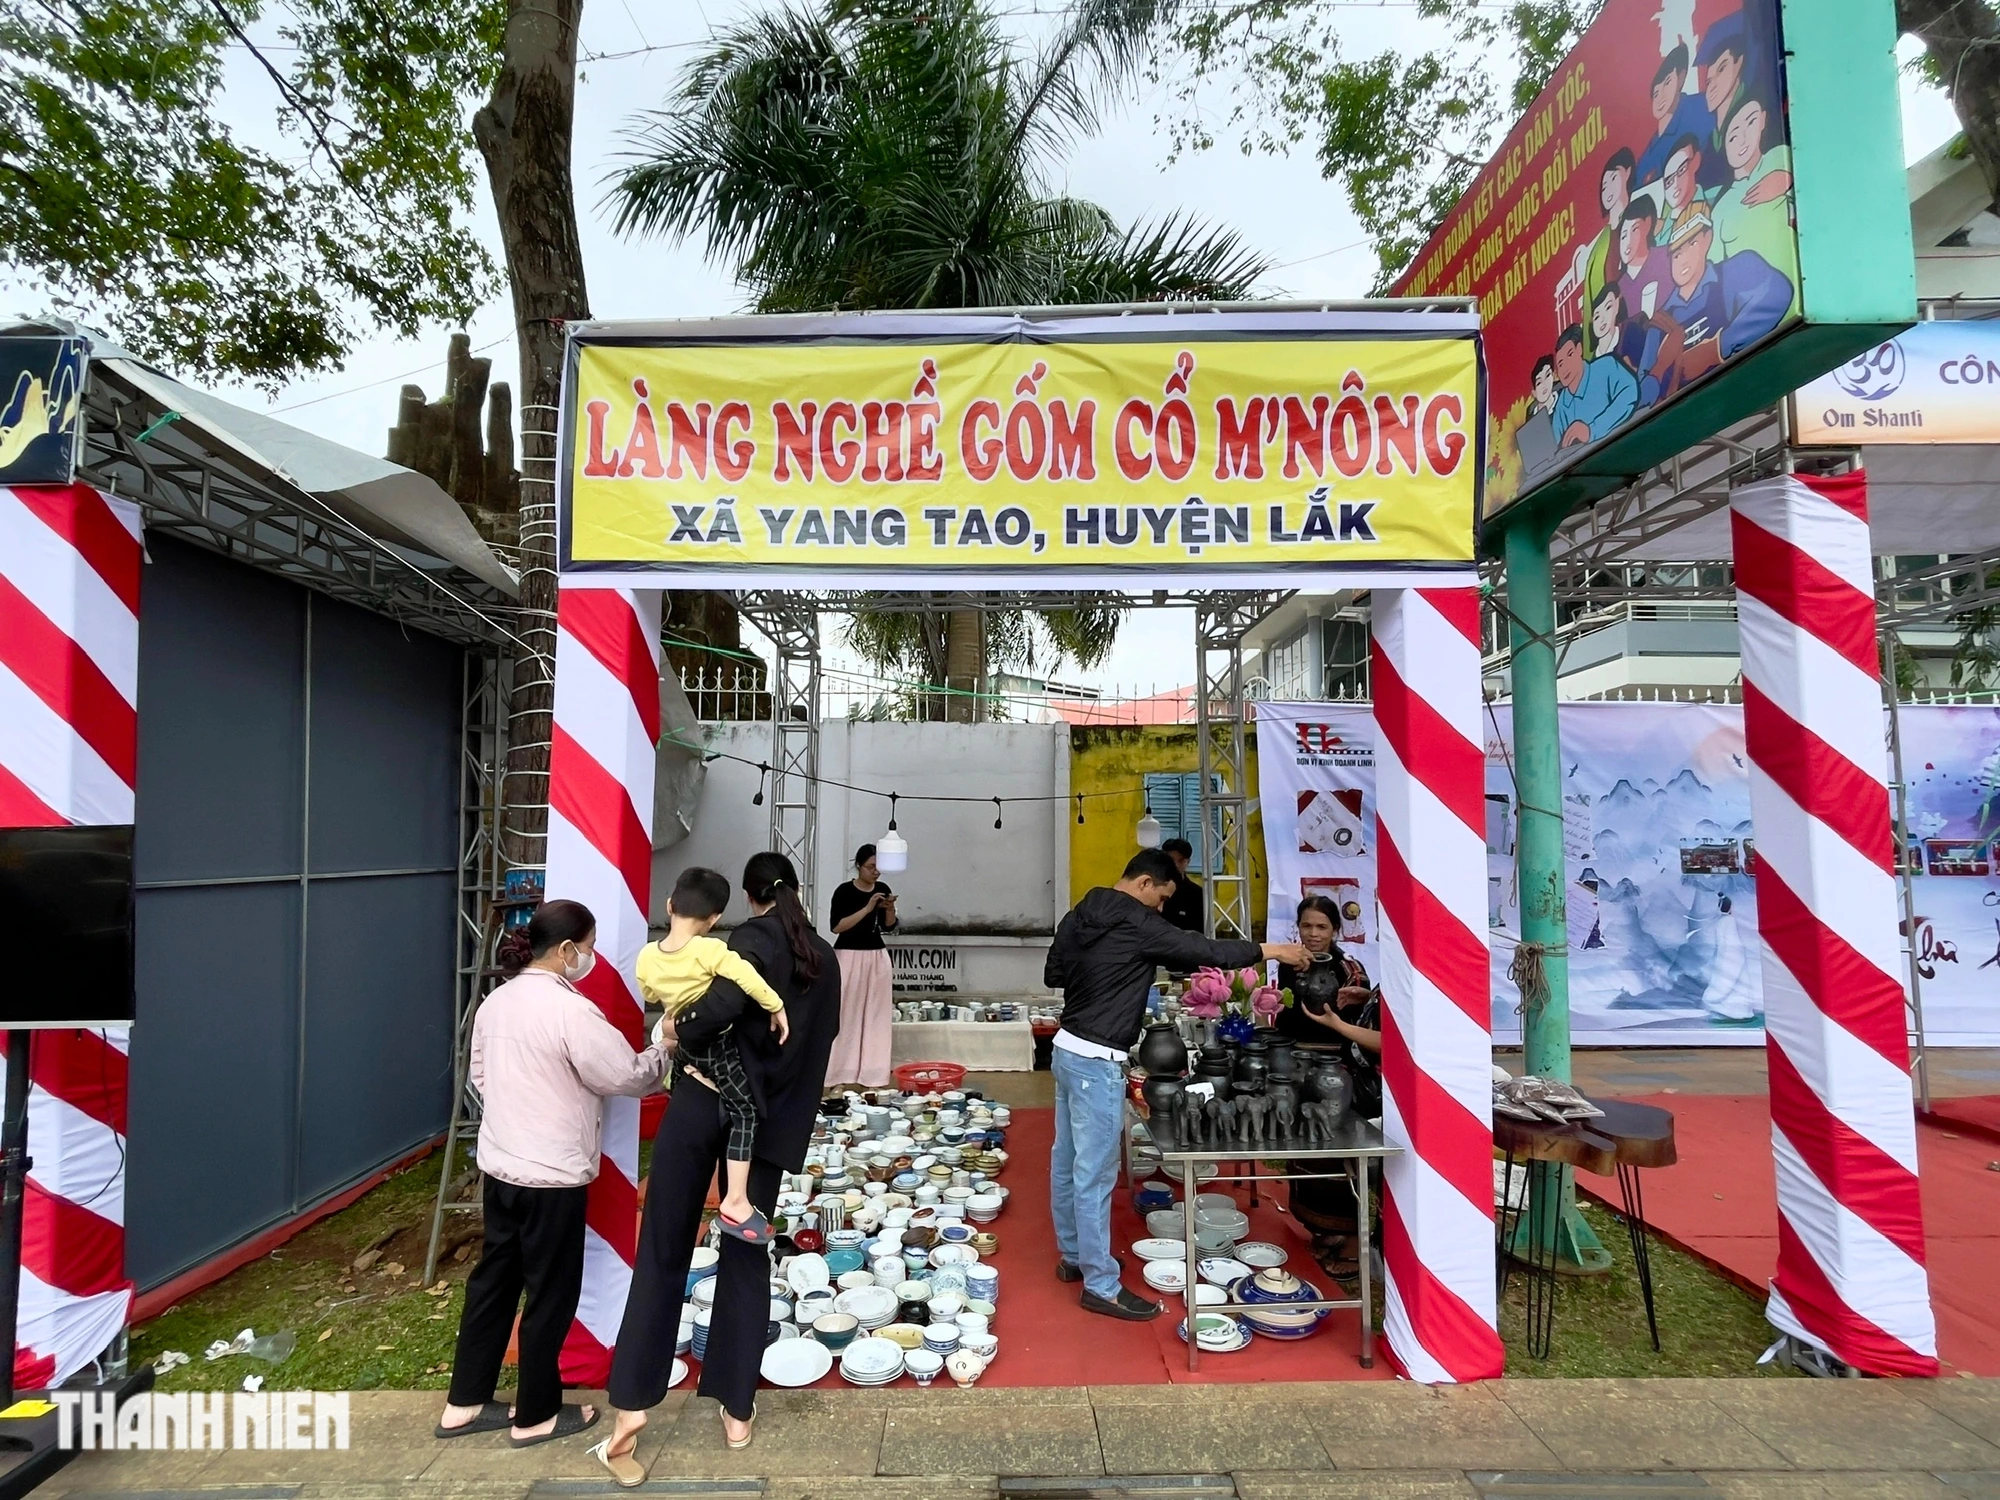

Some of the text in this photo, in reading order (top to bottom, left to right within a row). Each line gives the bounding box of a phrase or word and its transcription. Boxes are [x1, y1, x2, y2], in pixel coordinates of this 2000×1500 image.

[1445, 207, 1472, 265] ĐOÀN
[1474, 175, 1494, 229] KẾT
[1497, 145, 1521, 199] CÁC
[1525, 102, 1553, 166] DÂN
[1556, 62, 1591, 125] TỘC,
[1472, 225, 1503, 282] CÔNG
[1505, 182, 1540, 245] CUỘC
[1543, 138, 1567, 204] ĐỔI
[1571, 105, 1608, 171] MỚI,
[1504, 247, 1527, 305] ĐẤT
[1531, 201, 1575, 277] NƯỚC!
[584, 351, 1466, 483] LÀNG NGHỀ GỐM CỔ M'NÔNG
[1822, 408, 1923, 428] Om Shanti
[669, 487, 1377, 555] XÃ YANG TAO, HUYỆN LẮK
